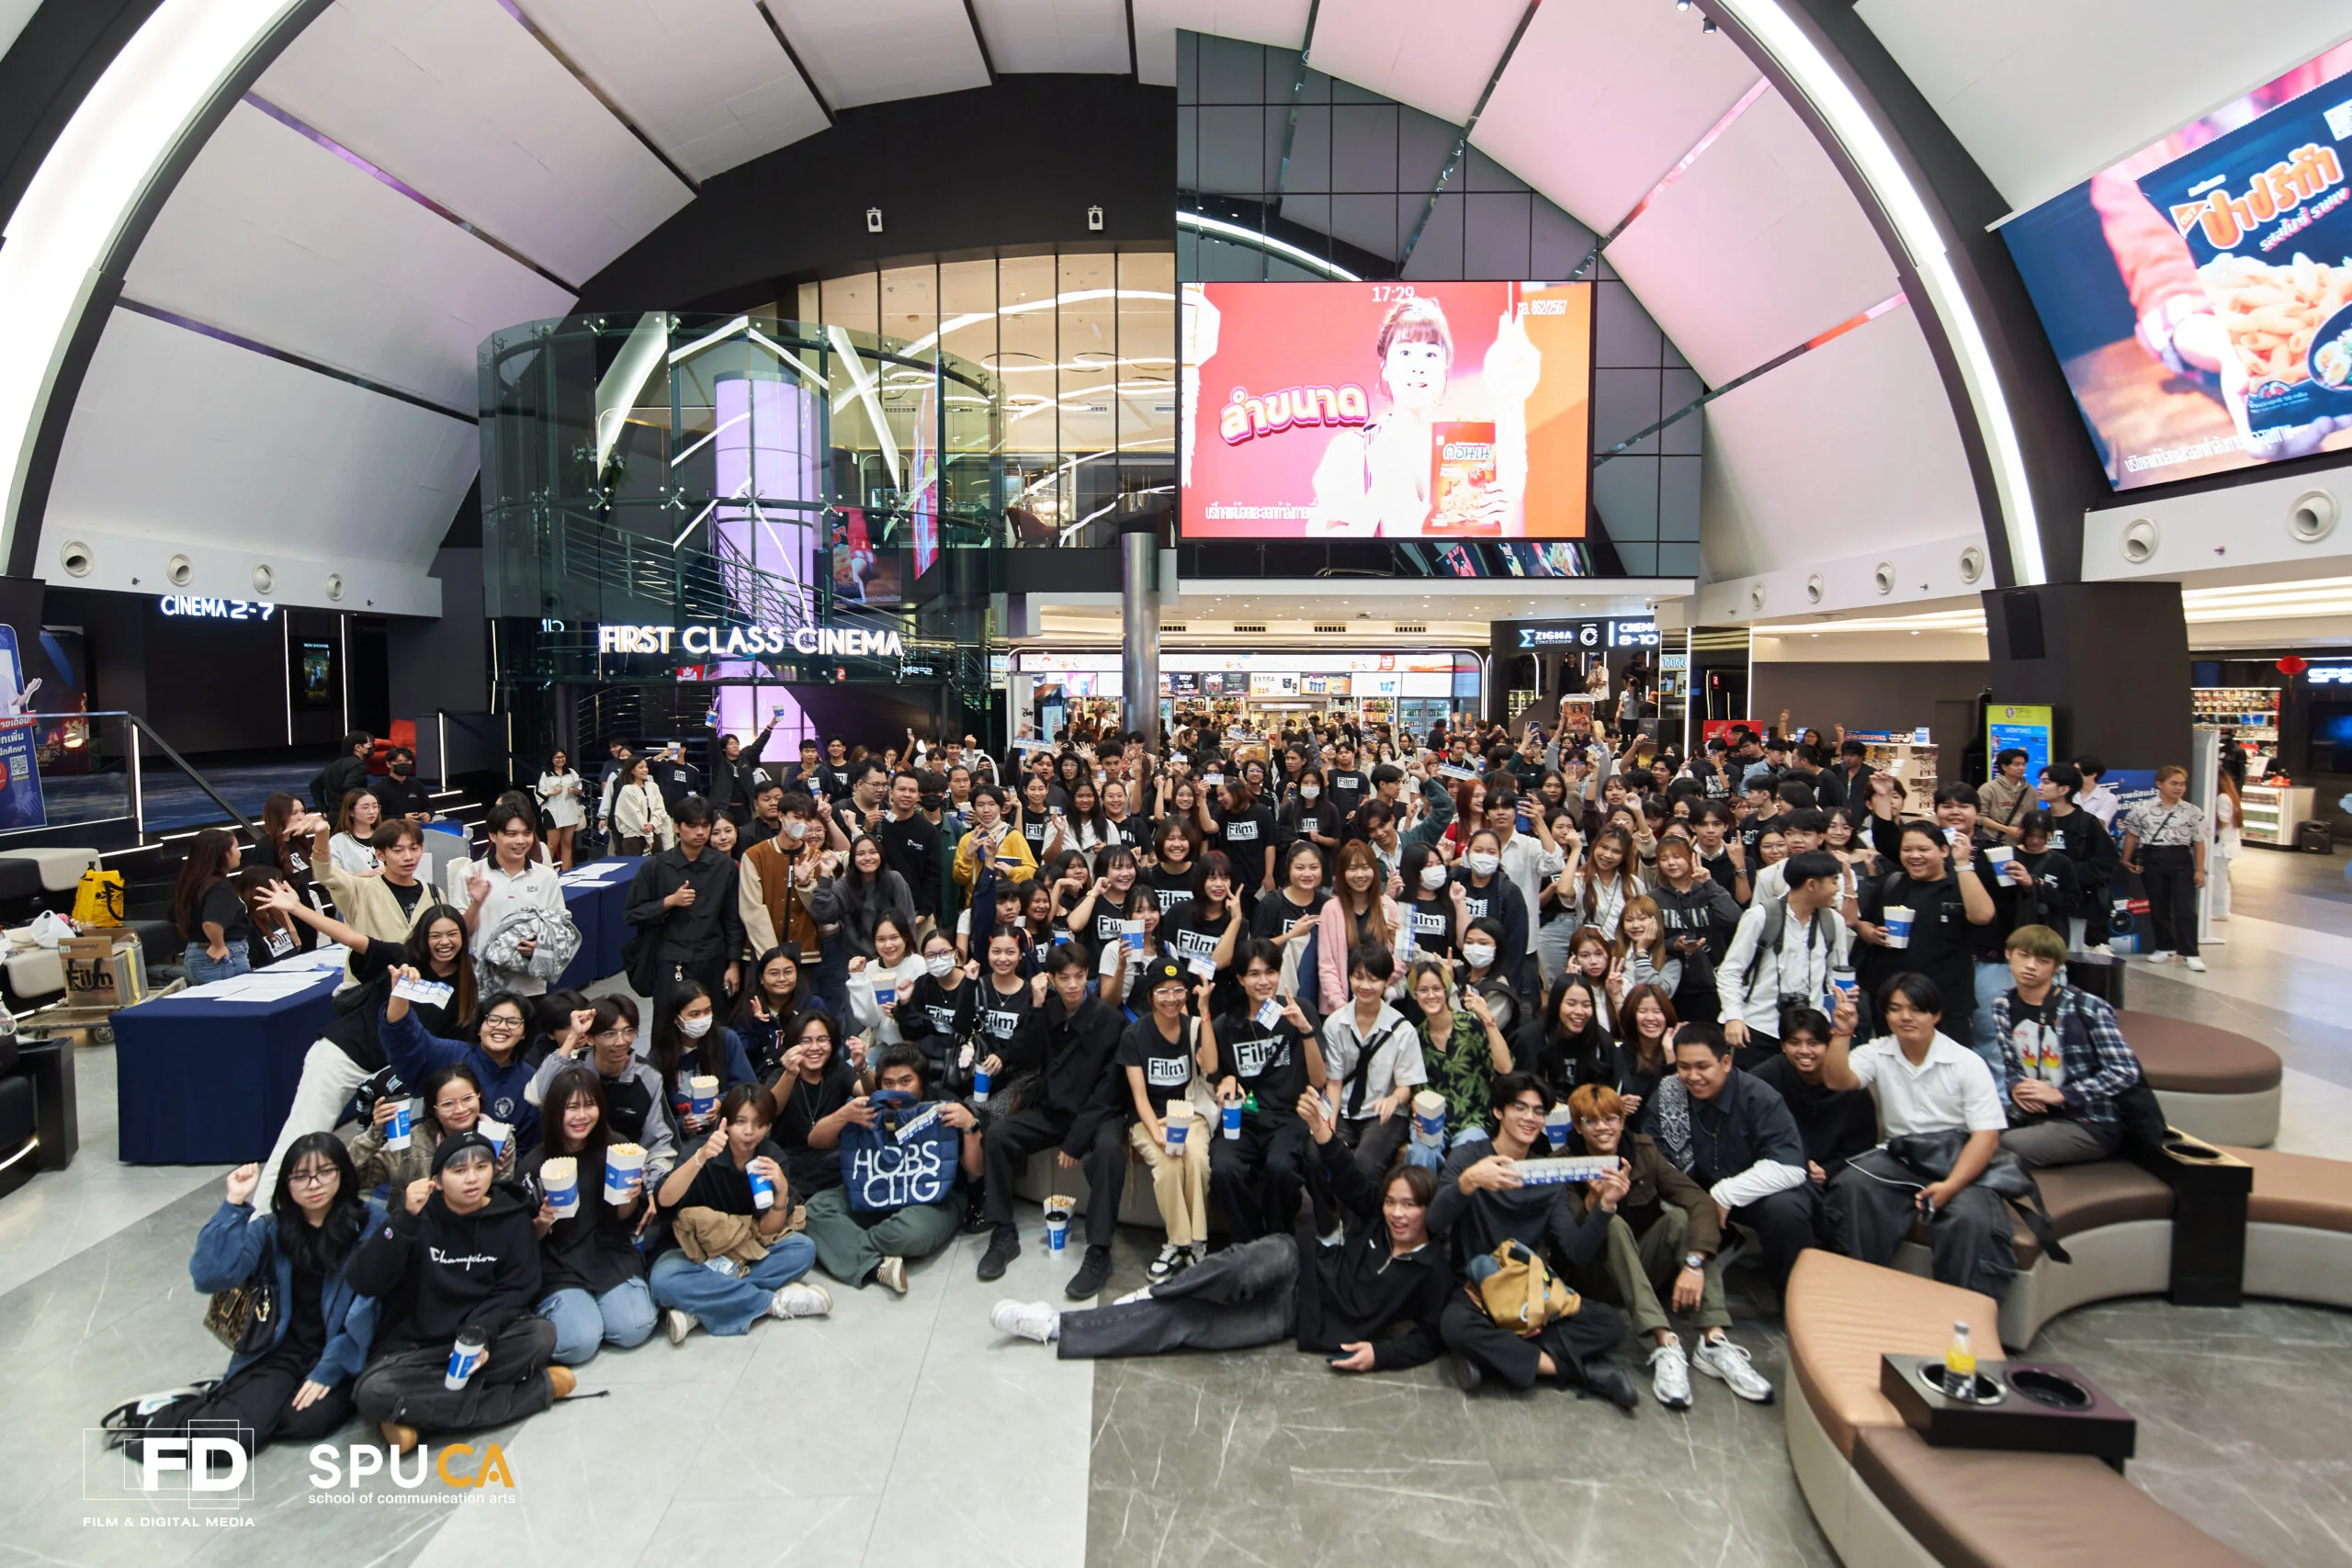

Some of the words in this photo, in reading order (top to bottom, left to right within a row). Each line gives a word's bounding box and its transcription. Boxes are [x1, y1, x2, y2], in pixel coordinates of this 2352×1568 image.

[1372, 286, 1415, 301] 17:29
[1532, 299, 1567, 315] 862/2567
[161, 595, 228, 617] CINEMA
[231, 599, 275, 621] 2-7
[600, 626, 674, 654] FIRST
[682, 626, 785, 654] CLASS
[793, 628, 904, 656] CINEMA
[1535, 631, 1573, 640] ZIGMA
[1619, 635, 1658, 645] 8-10
[1228, 823, 1253, 834] Film
[1179, 931, 1216, 953] Film
[66, 968, 113, 987] Film
[1150, 1060, 1184, 1077] Film
[853, 1140, 941, 1180] HOBS
[430, 1247, 498, 1271] Champion
